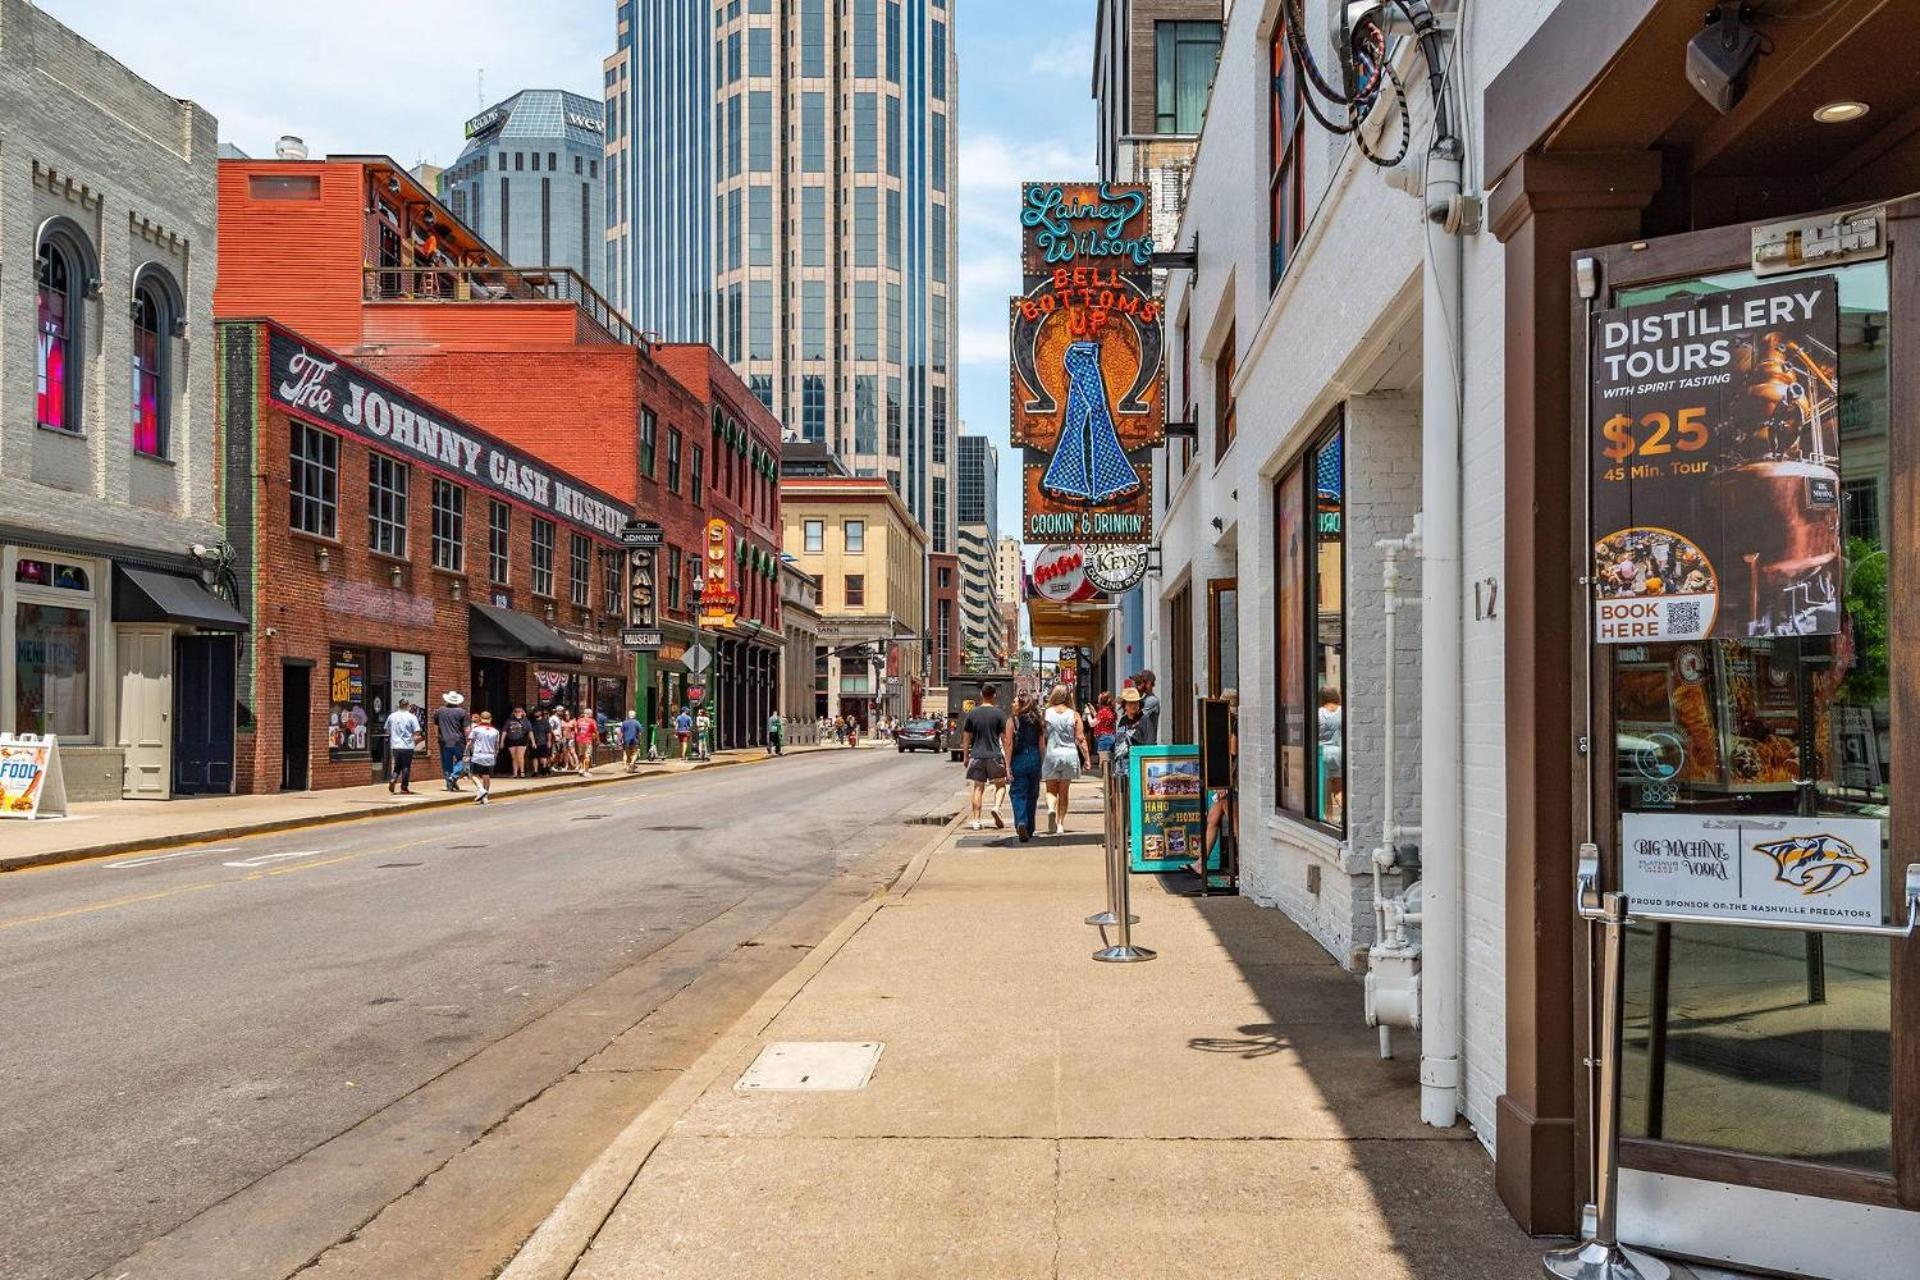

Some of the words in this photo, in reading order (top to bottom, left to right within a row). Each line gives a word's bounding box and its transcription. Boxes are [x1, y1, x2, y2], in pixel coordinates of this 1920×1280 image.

[1020, 183, 1145, 240] Lainey
[1037, 230, 1154, 266] Wilson's
[1054, 268, 1125, 289] BELL
[1021, 289, 1160, 322] BOTTOMS
[1069, 310, 1106, 335] UP
[1605, 290, 1822, 349] DISTILLERY
[1604, 339, 1731, 381] TOURS
[1604, 386, 1634, 400] WITH
[1637, 380, 1674, 395] SPIRIT
[1679, 373, 1731, 389] TASTING
[279, 346, 337, 413] The
[342, 382, 481, 475] JOHNNY
[489, 450, 550, 506] CASH
[555, 481, 628, 538] MUSEUM
[1603, 407, 1708, 464] $25
[1604, 468, 1625, 481] 45
[1631, 464, 1664, 479] Min.
[1670, 461, 1709, 476] Tour
[1031, 512, 1078, 534] COOKIN'
[1081, 512, 1091, 535] &
[1094, 513, 1145, 533] DRINKIN'
[624, 534, 660, 543] JOHNNY
[709, 527, 725, 579] SUN
[1098, 551, 1138, 572] KEYS
[631, 548, 653, 625] CASH
[1601, 602, 1660, 620] BOOK
[624, 634, 661, 645] MUSEUM
[1602, 621, 1660, 639] HERE
[0, 763, 38, 779] FOOD
[1634, 839, 1661, 857] BIG
[1661, 839, 1730, 861] MACHINE
[1682, 859, 1729, 881] VODKA
[1631, 898, 1662, 906] PROUD
[1665, 900, 1709, 908] SPONSOR
[1729, 903, 1748, 911] THE
[1751, 904, 1806, 914] NASHVILLE
[1810, 907, 1872, 918] PREDATORS
